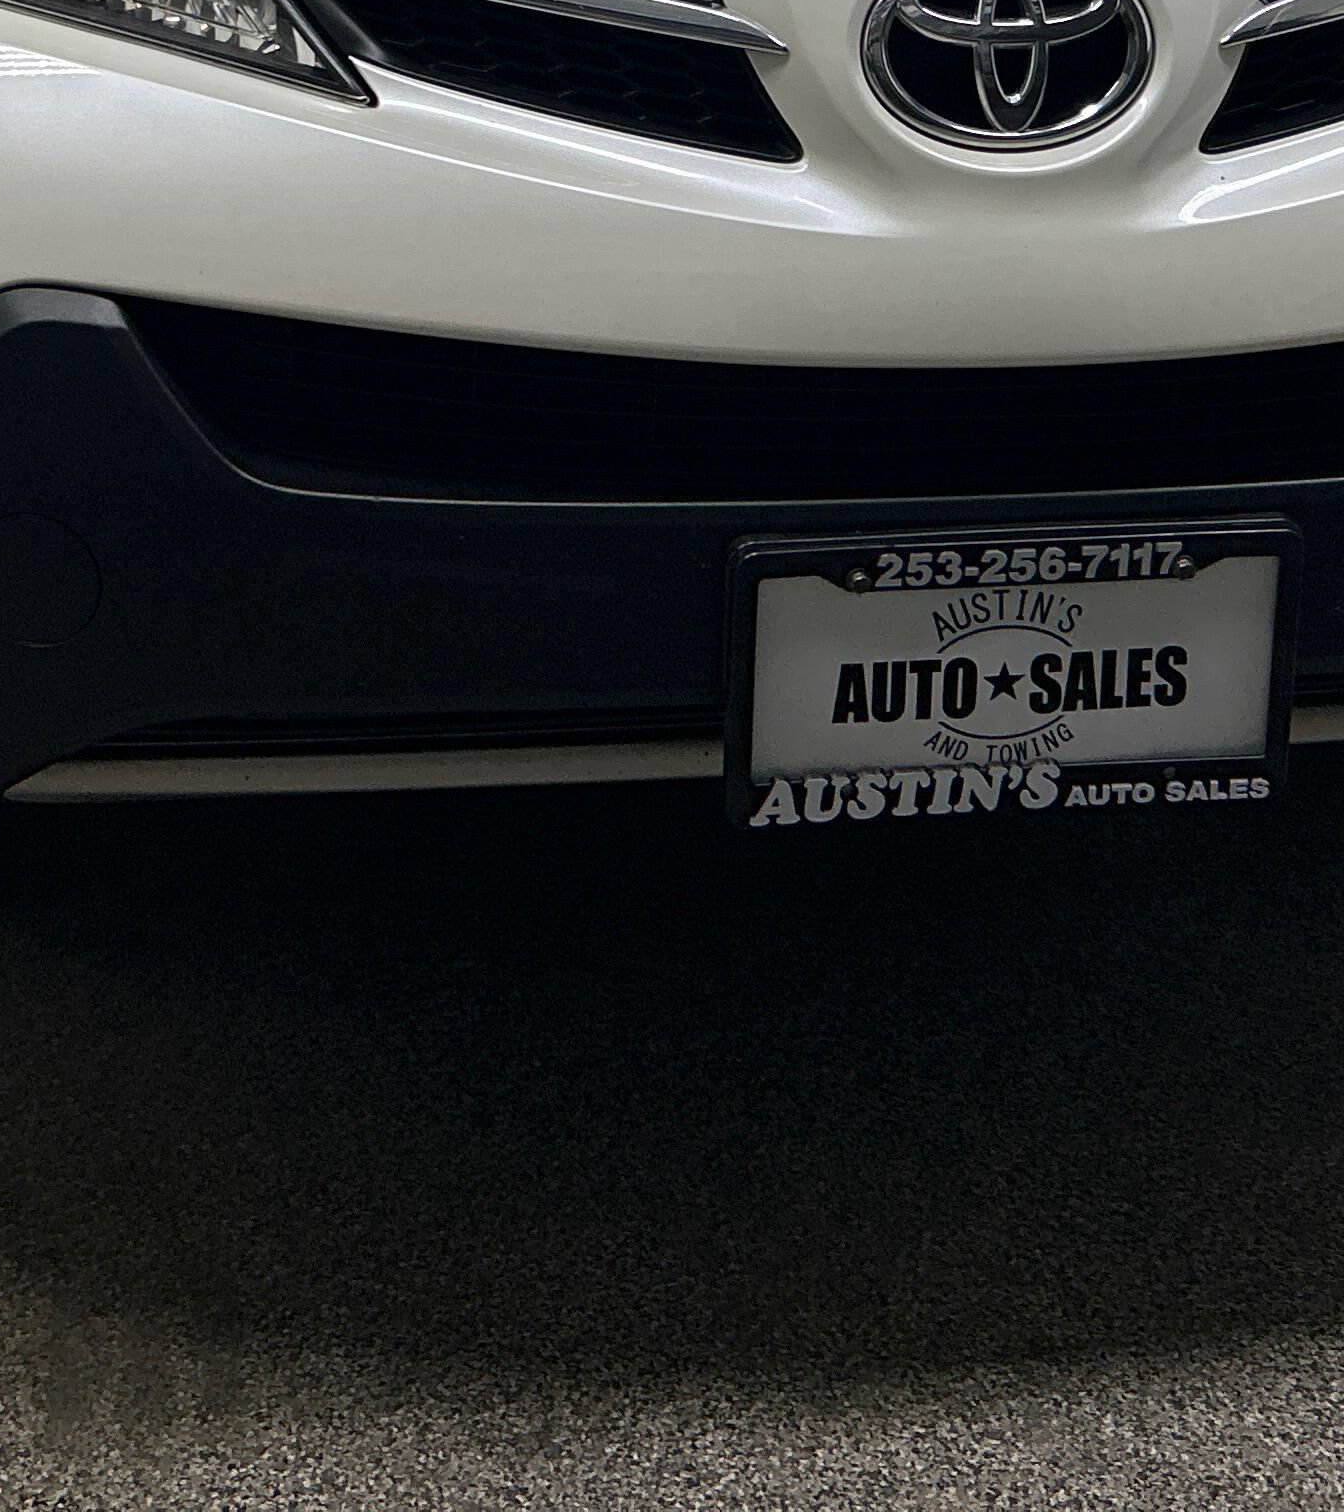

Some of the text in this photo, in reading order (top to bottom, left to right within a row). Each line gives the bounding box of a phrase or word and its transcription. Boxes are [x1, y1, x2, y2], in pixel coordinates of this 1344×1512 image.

[875, 542, 1183, 588] 253-256-7117
[932, 589, 1083, 641] AUSTIN'S
[831, 645, 1188, 724] AUTO SALES
[923, 723, 1075, 765] AND TOWING
[749, 763, 1270, 827] AUSTIN'S AUTO SALES
